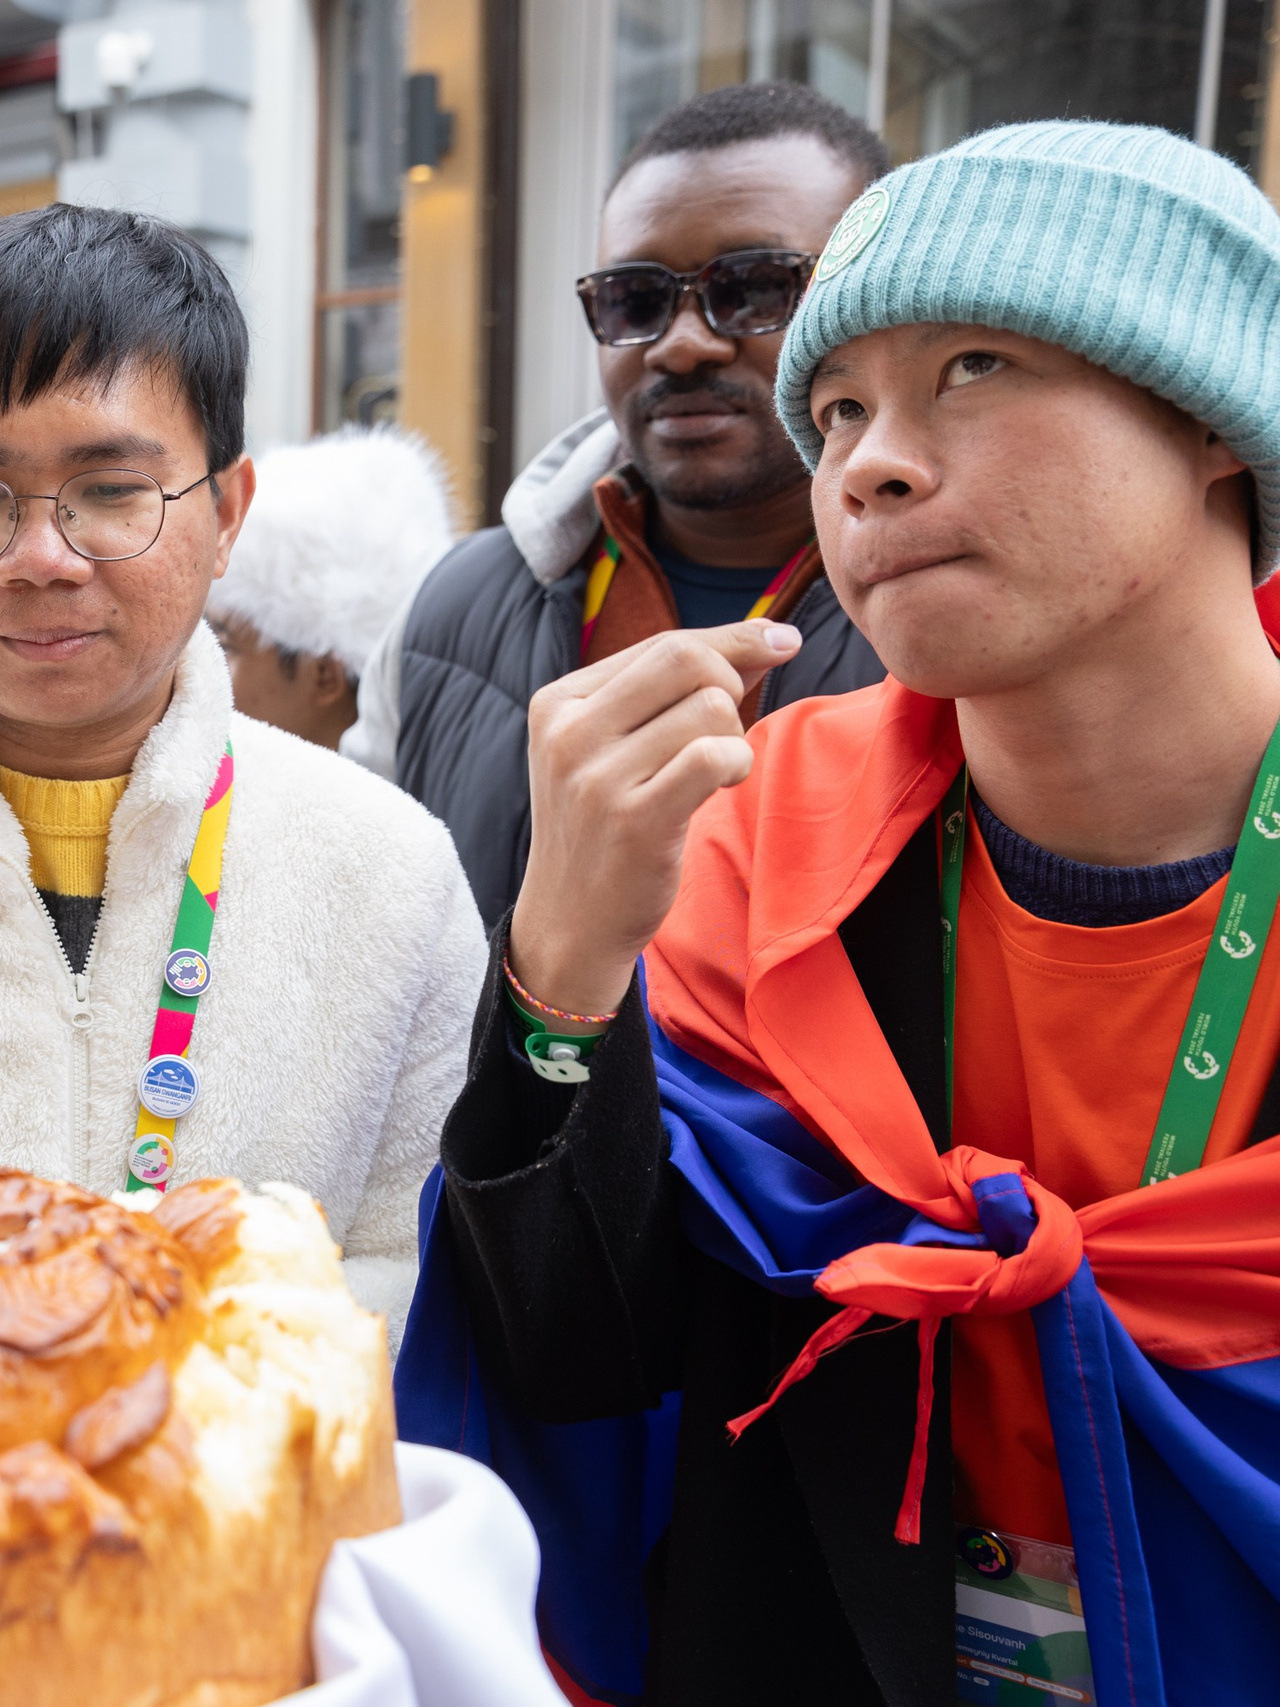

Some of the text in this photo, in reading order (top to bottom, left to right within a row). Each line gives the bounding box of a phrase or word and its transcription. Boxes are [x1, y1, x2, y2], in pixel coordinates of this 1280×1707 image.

[1192, 1012, 1205, 1038] FESTIVAL
[1195, 1014, 1211, 1056] WORLD YOUTH
[967, 1626, 1026, 1650] Sisouvanh
[991, 1654, 1018, 1666] Kvartal
